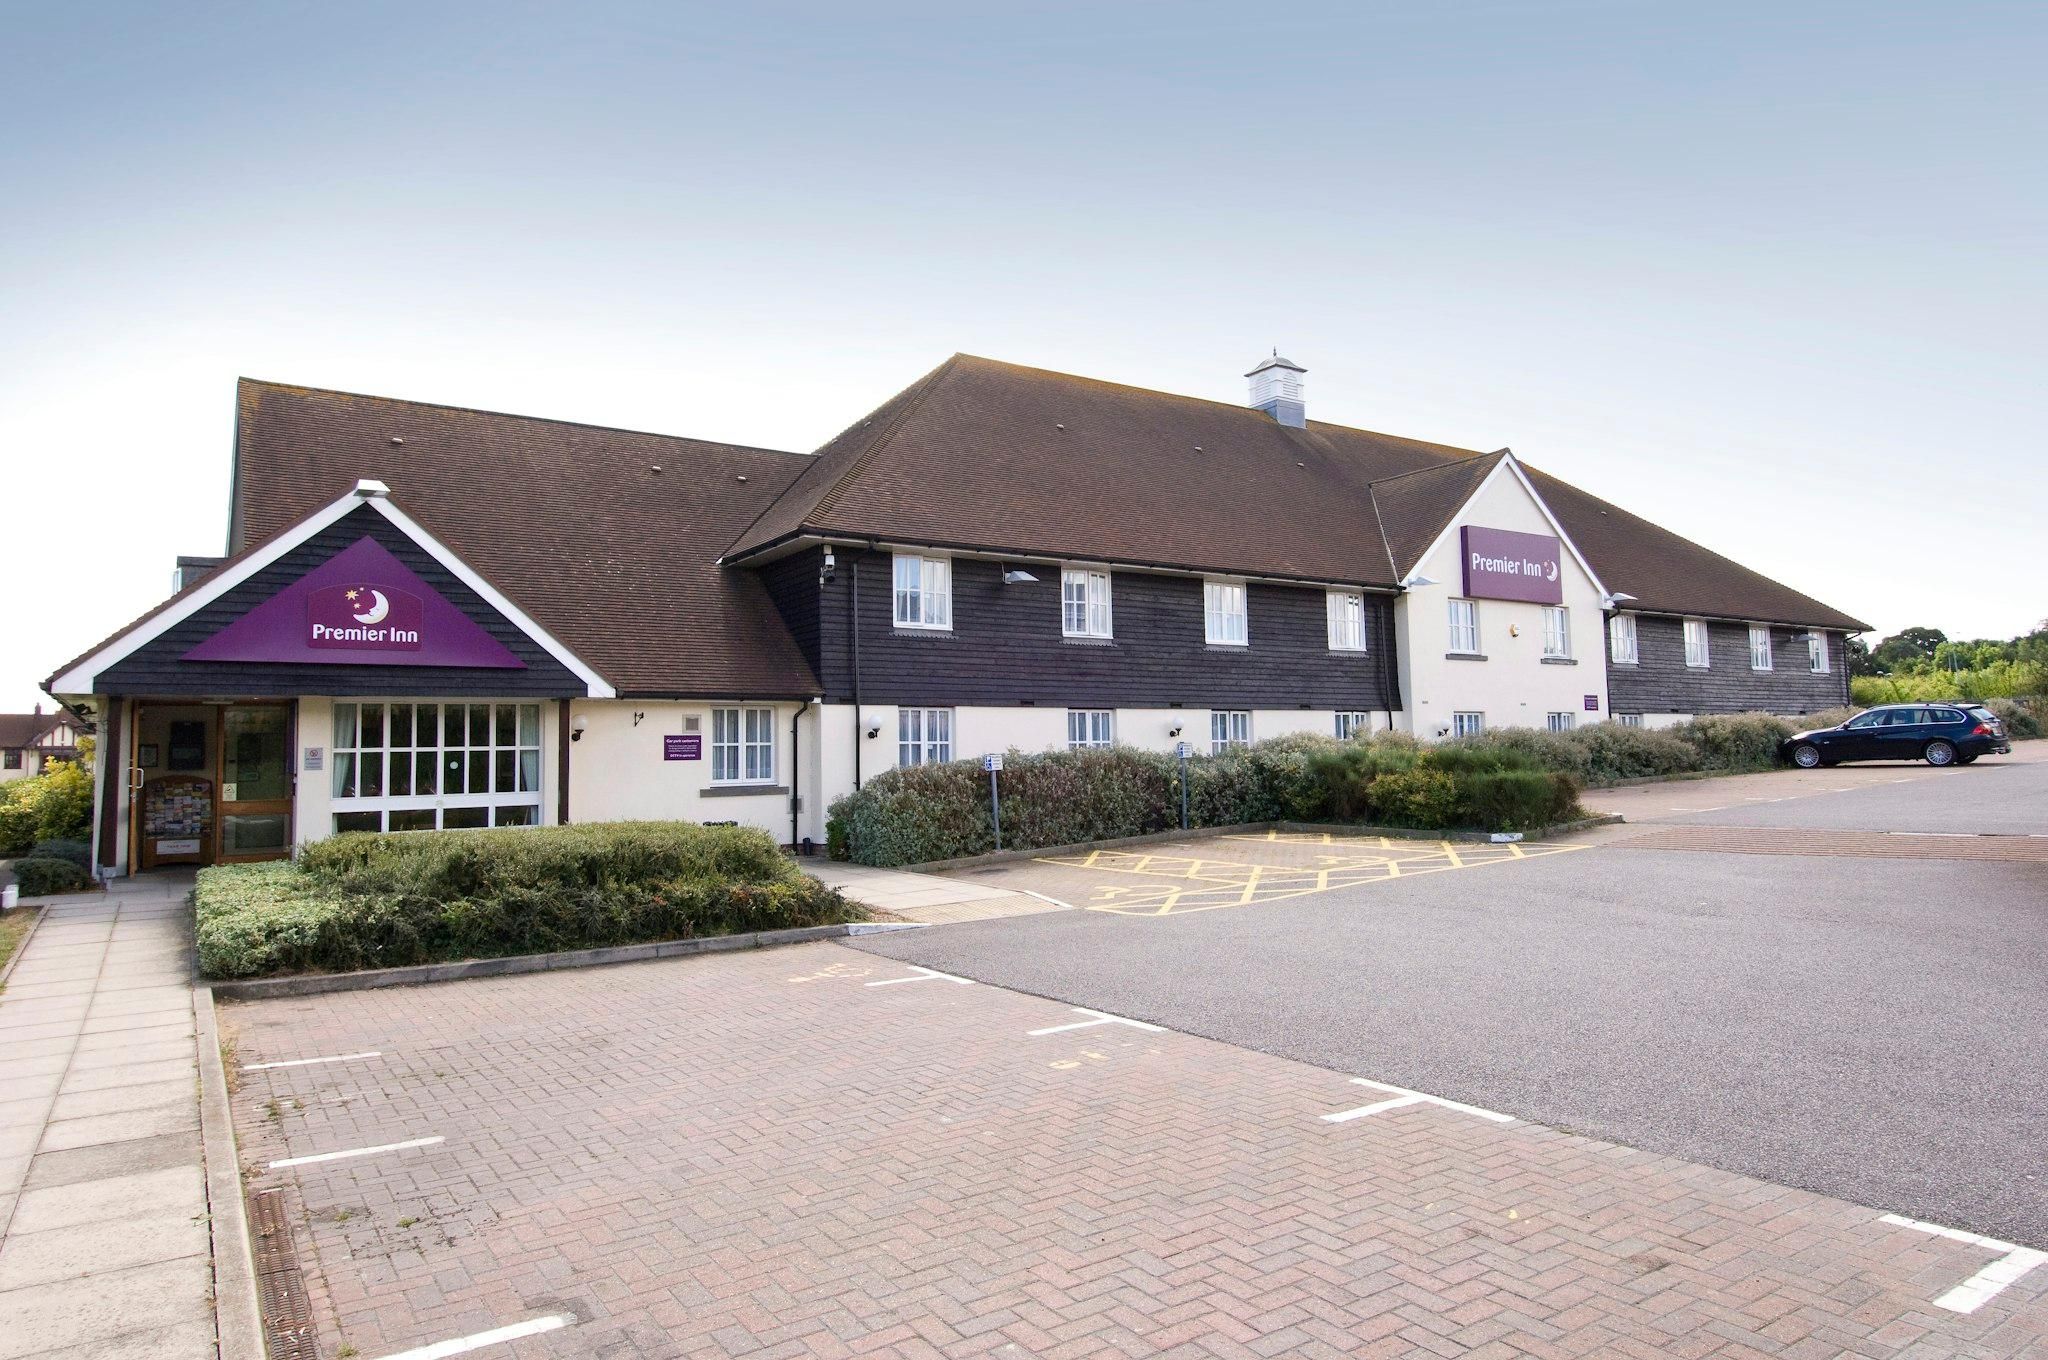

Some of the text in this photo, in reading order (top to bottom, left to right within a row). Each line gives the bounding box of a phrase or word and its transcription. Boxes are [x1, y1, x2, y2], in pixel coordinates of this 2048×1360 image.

[1472, 553, 1541, 576] Premier Inn
[312, 624, 418, 642] Premier Inn
